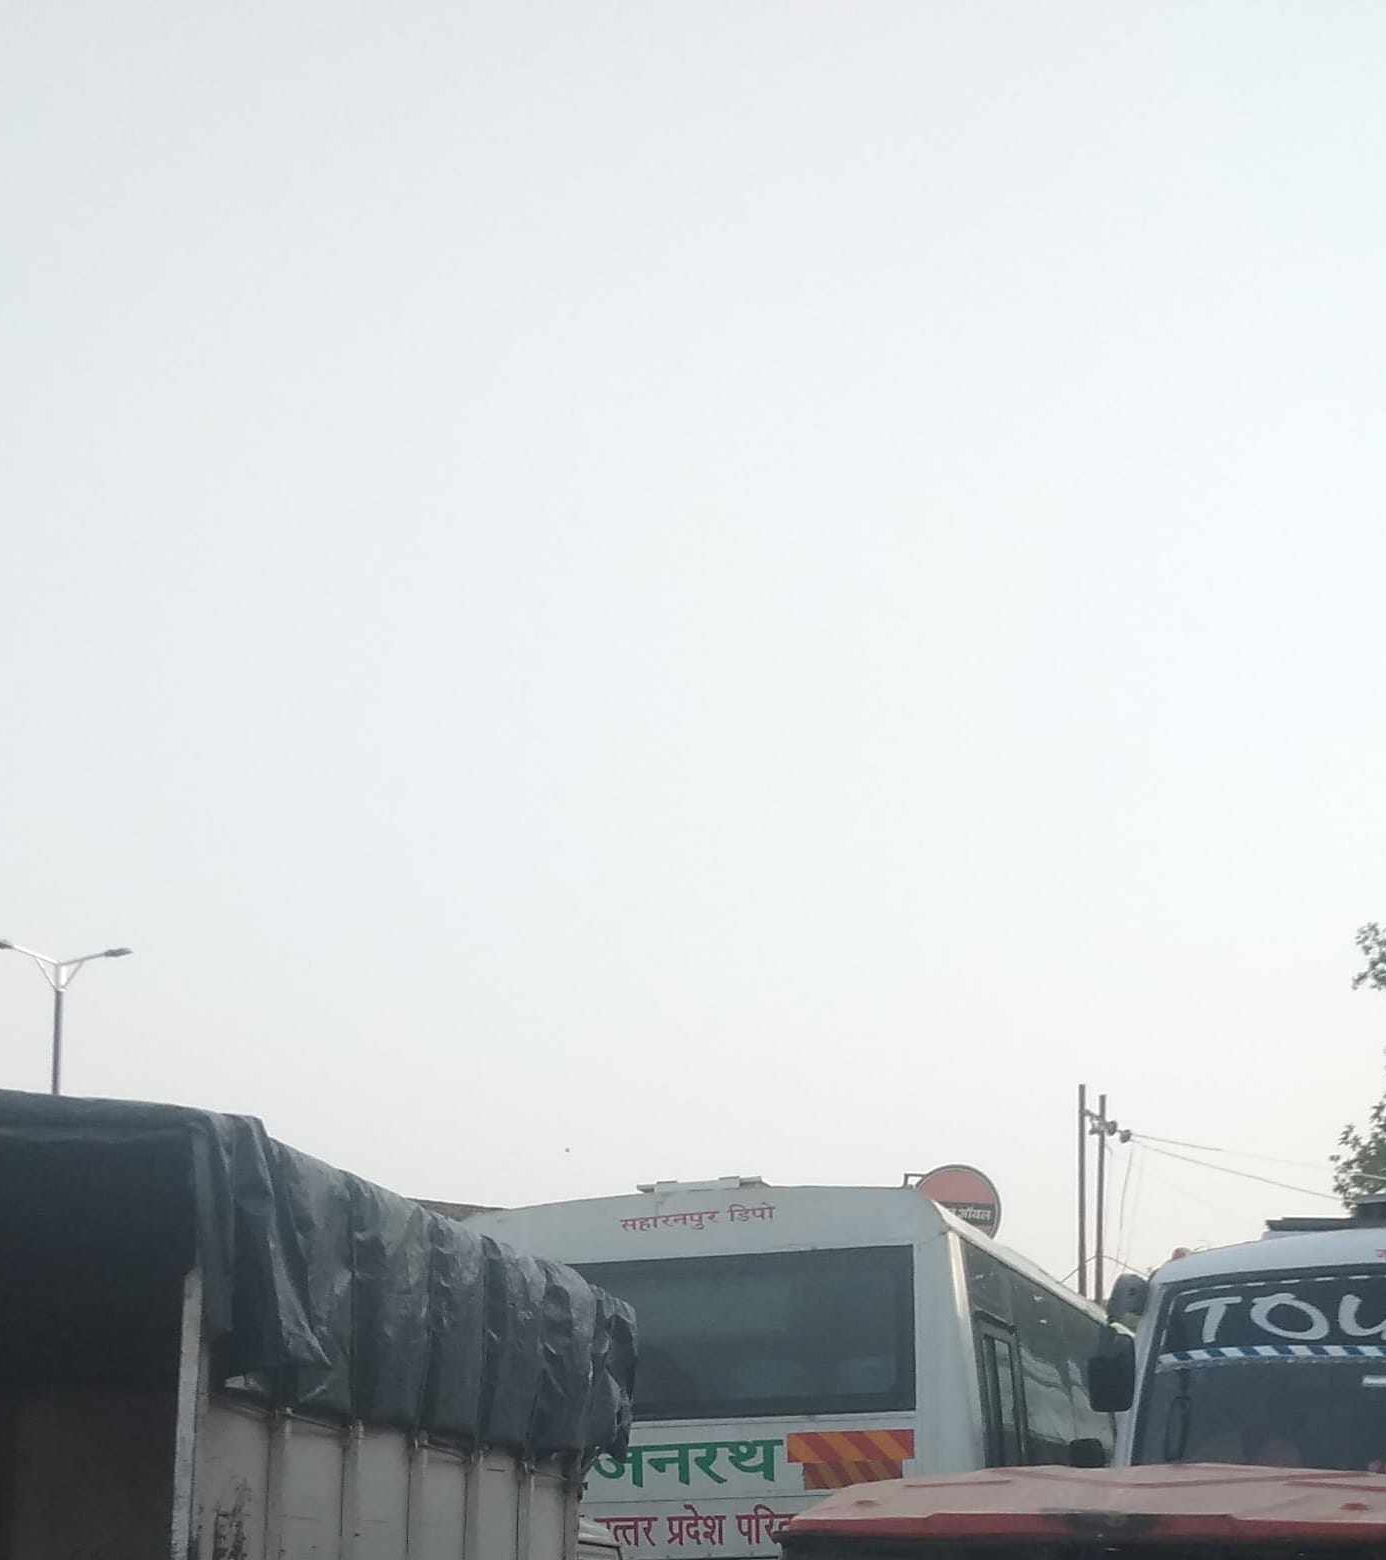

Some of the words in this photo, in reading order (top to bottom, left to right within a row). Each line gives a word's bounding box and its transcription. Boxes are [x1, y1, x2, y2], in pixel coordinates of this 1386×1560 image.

[620, 1211, 719, 1233] सहारनपुर
[729, 1203, 776, 1223] डिपो
[667, 1504, 726, 1546] प्रदेश
